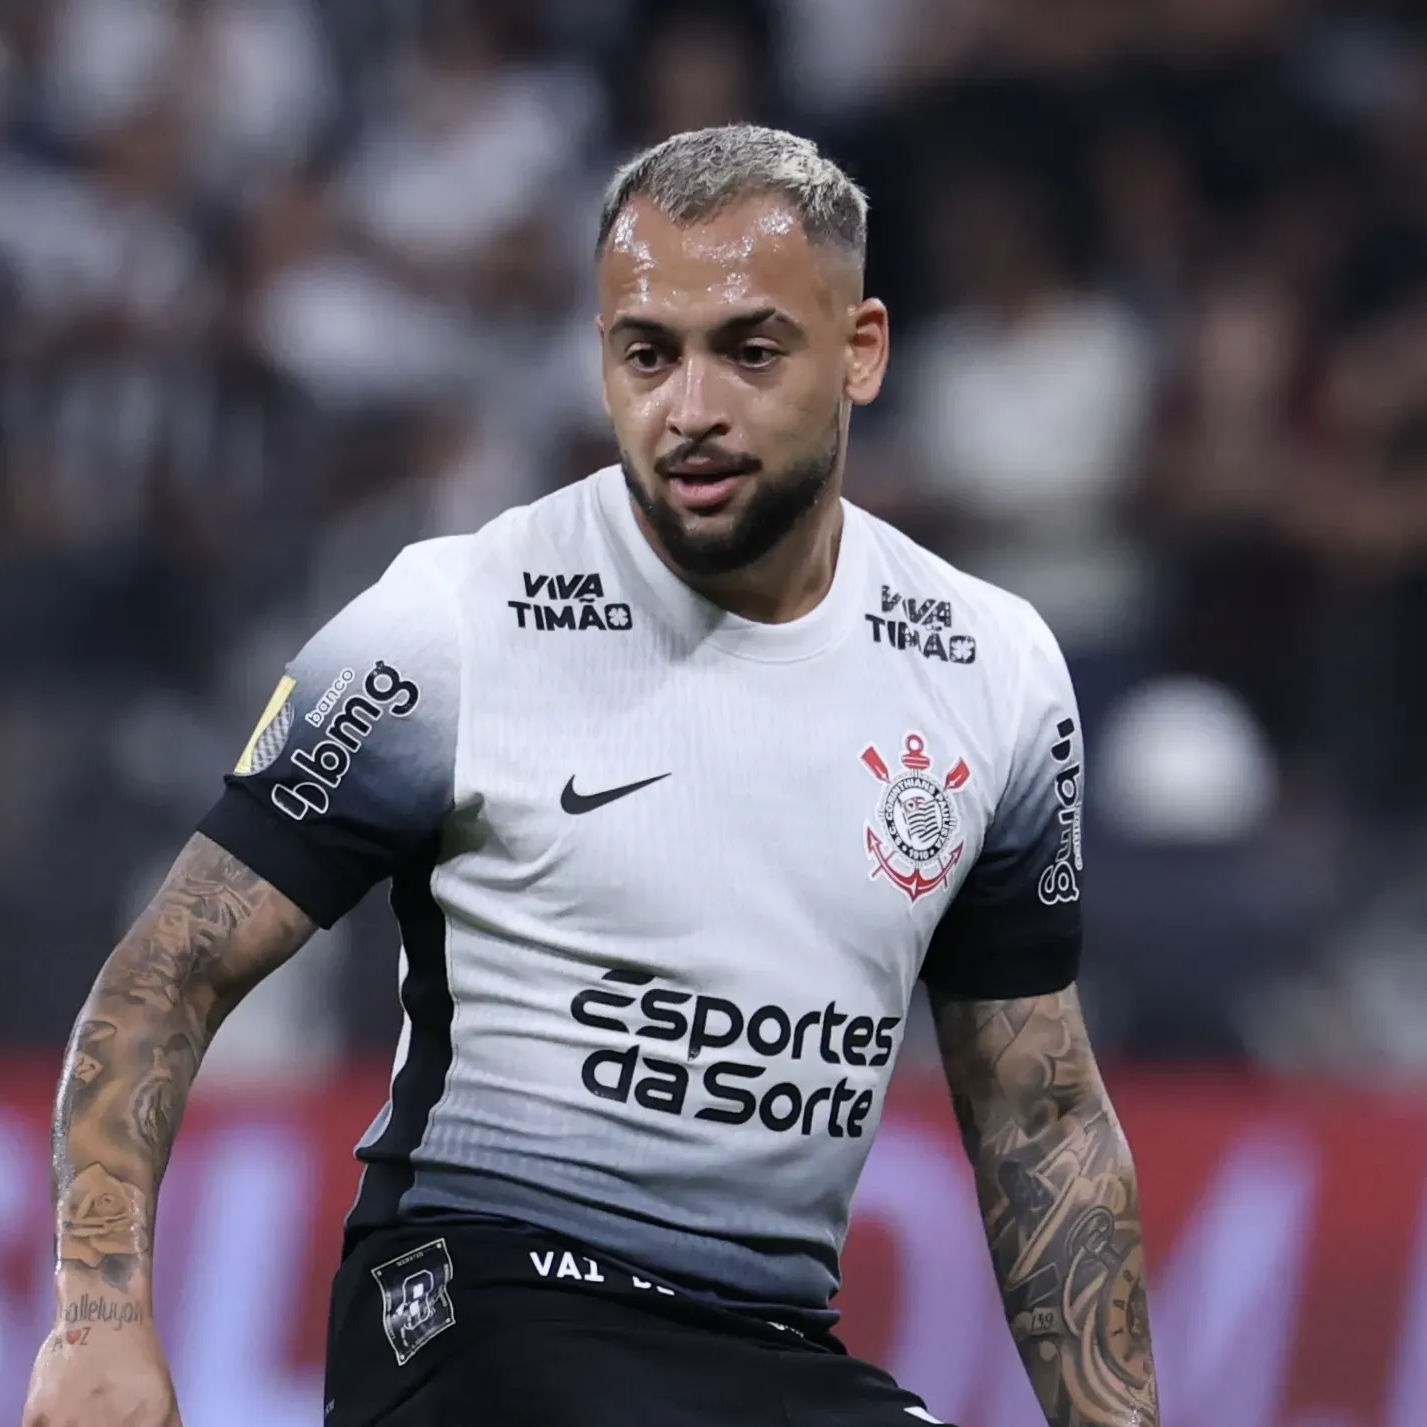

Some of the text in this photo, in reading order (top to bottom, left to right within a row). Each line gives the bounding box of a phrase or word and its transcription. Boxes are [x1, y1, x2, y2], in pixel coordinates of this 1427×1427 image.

[523, 571, 605, 601] VIVA
[290, 660, 421, 789] bmg
[304, 667, 355, 728] banco
[886, 777, 936, 821] CORINTHIANS
[933, 792, 951, 850] PAULISTA
[908, 847, 930, 862] 1910
[570, 968, 902, 1067] Esportes
